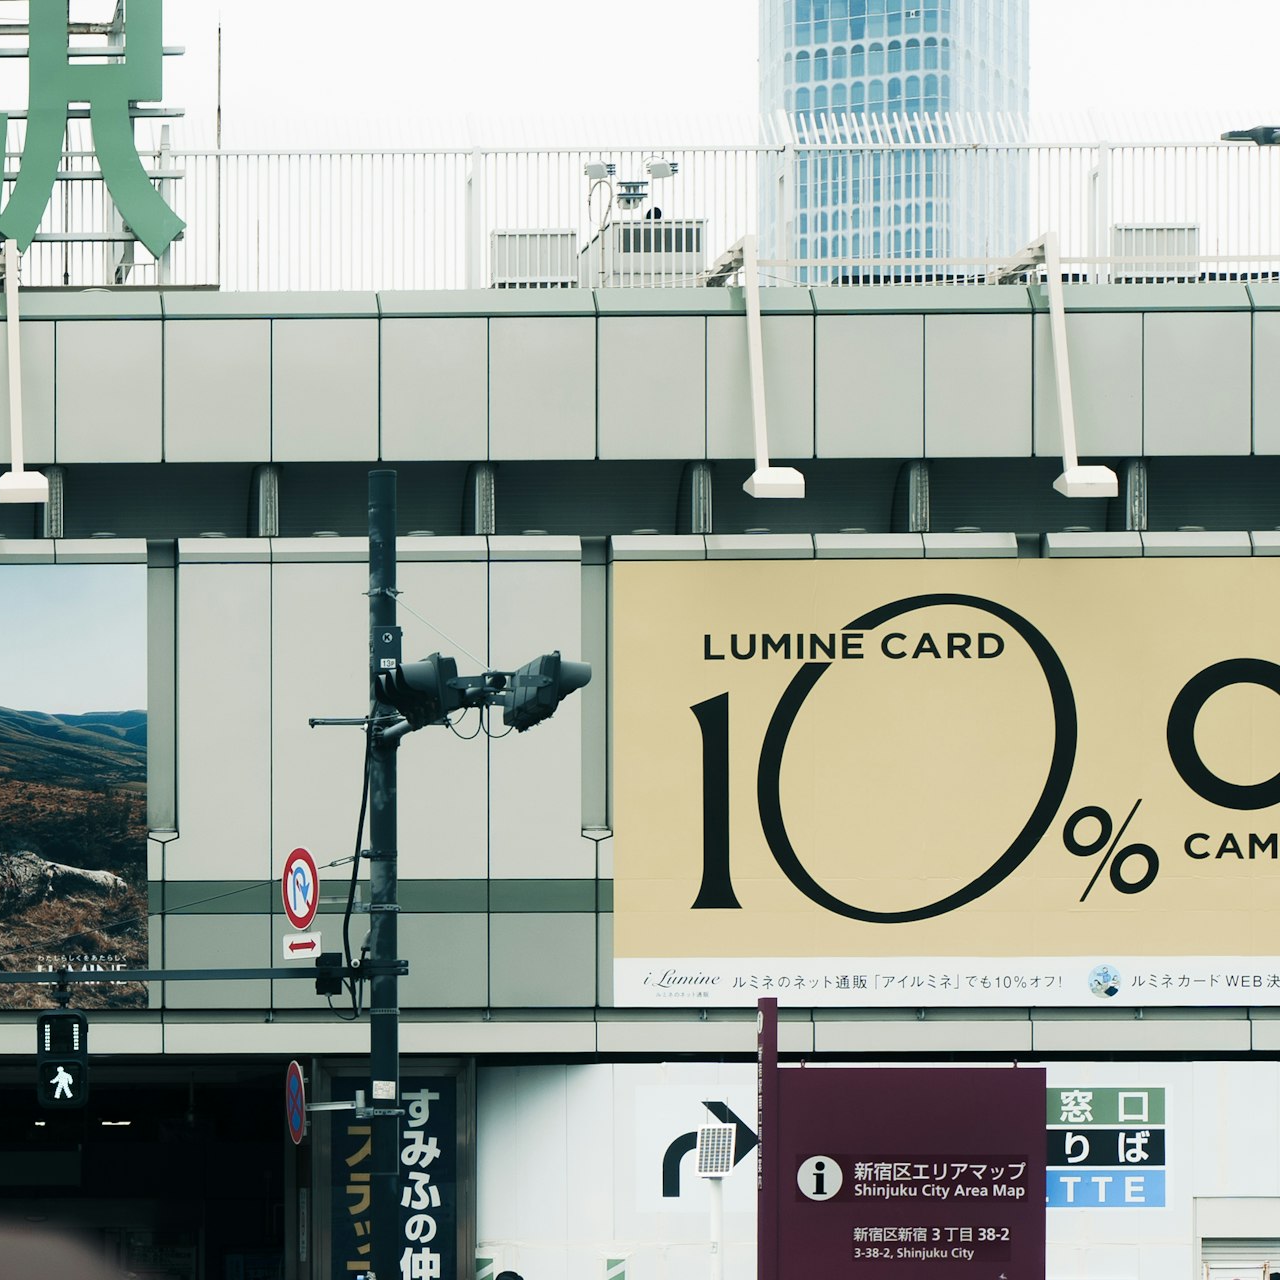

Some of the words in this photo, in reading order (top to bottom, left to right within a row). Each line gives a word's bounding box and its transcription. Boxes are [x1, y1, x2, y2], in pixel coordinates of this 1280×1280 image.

[703, 633, 865, 661] LUMINE
[880, 632, 1006, 660] CARD
[1183, 832, 1279, 860] CAM
[37, 954, 128, 962] わたしらしくをあたらしく
[652, 969, 720, 989] Lumine
[1060, 1089, 1149, 1123] 窓口
[1064, 1130, 1150, 1163] りば
[854, 1162, 1026, 1181] 新宿区エリアマップ
[854, 1184, 918, 1199] Shinjuku
[921, 1184, 950, 1199] City
[954, 1184, 988, 1197] Area
[993, 1184, 1026, 1199] Map
[1046, 1176, 1146, 1203] TTE
[978, 1228, 1010, 1241] 38-2
[854, 1247, 894, 1259] 3-38-2,
[897, 1247, 948, 1260] Shinjuku
[951, 1247, 975, 1260] City
